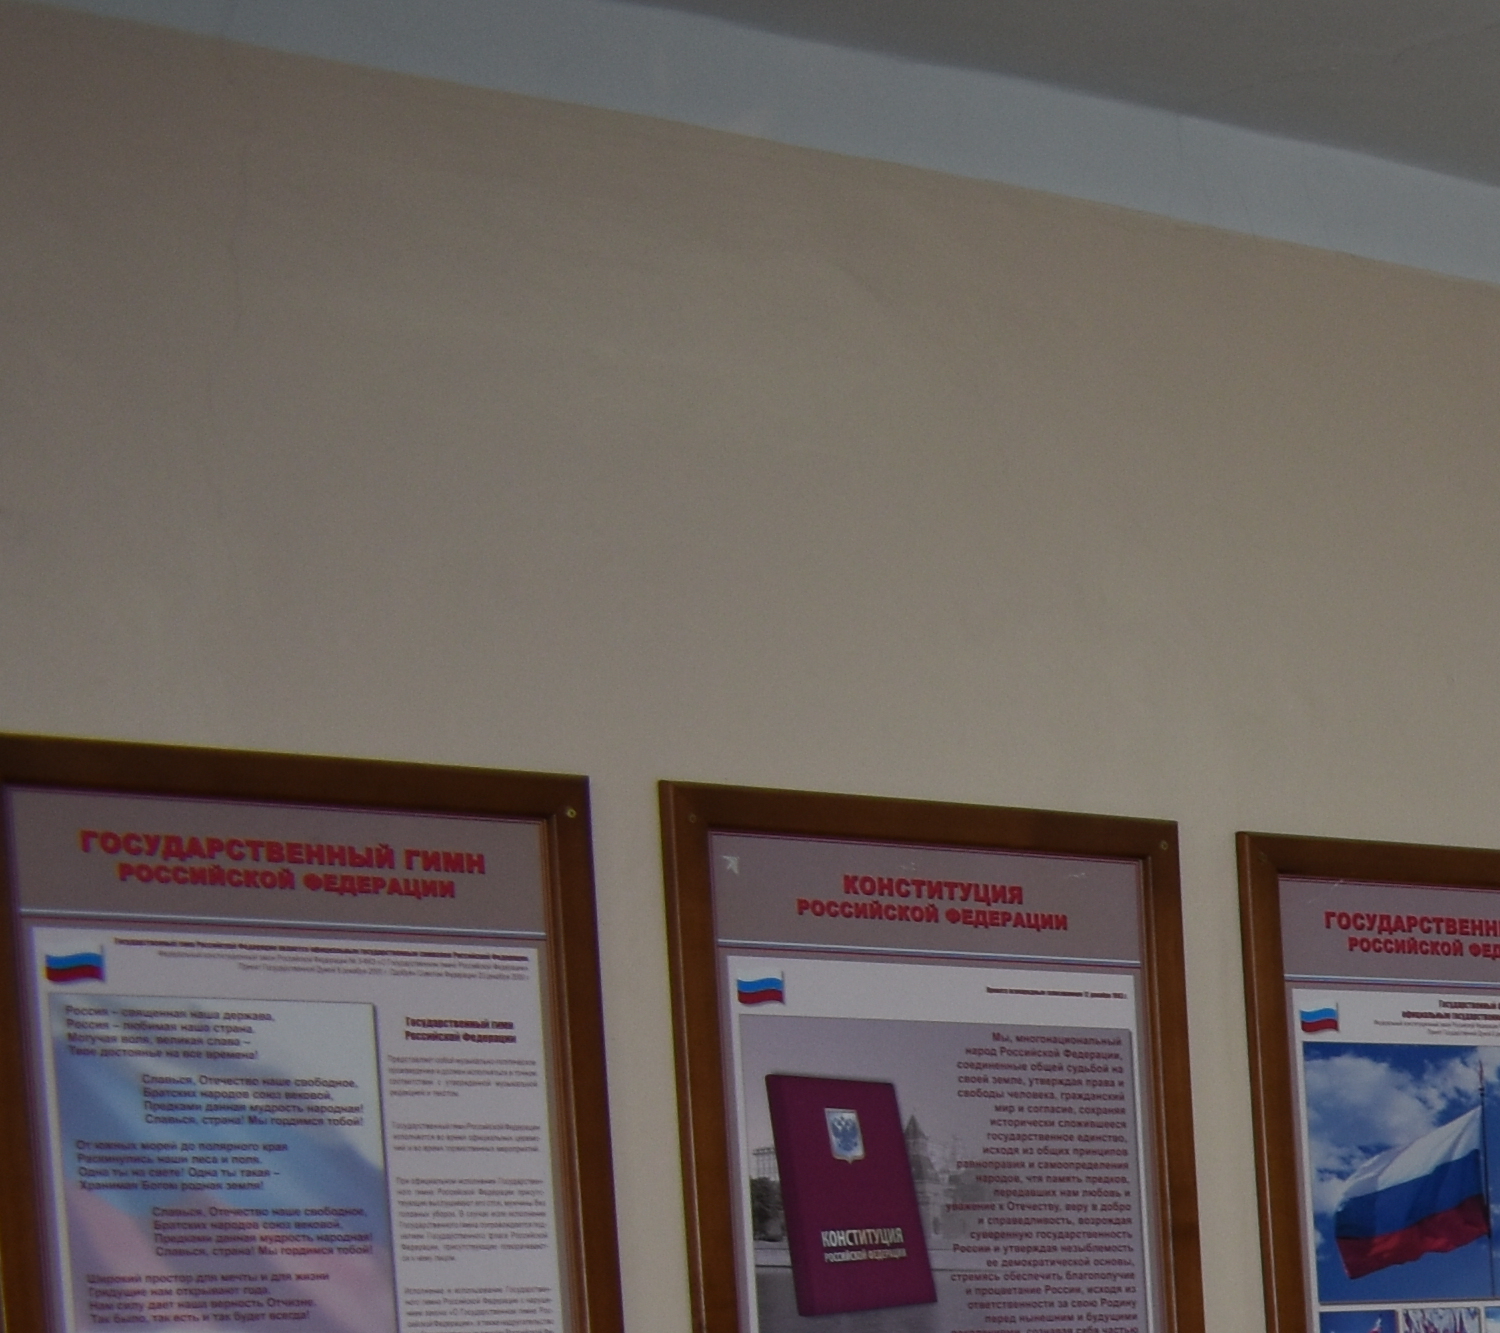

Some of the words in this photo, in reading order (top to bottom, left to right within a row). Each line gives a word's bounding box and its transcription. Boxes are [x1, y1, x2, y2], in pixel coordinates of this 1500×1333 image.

[80, 830, 394, 870] ГОСУДАРСТВЕННЫЙ
[404, 849, 486, 875] ГИМН
[119, 862, 296, 890] РОССИЙСКОЙ
[304, 873, 456, 900] ФЕДЕРАЦИИ
[843, 874, 1023, 906] КОНСТИТУЦИЯ
[797, 898, 939, 923] РОССИЙСКОЙ
[946, 908, 1068, 932] ФЕДЕРАЦИИ
[1349, 936, 1463, 956] РОССИЙСКОЙ
[1014, 1033, 1121, 1047] многонациональный
[965, 1048, 997, 1057] народ
[999, 1047, 1060, 1058] Российской
[957, 1062, 1027, 1072] соединенные
[1030, 1062, 1063, 1074] общей
[1066, 1063, 1109, 1075] судьбой
[958, 1075, 989, 1084] своей
[1028, 1078, 1083, 1088] утверждая
[1085, 1080, 1115, 1088] права
[957, 1089, 1004, 1100] свободы
[1059, 1091, 1125, 1102] гражданский
[995, 1106, 1015, 1114] мир
[1078, 1107, 1126, 1116] сохраняя
[990, 1120, 1055, 1129] исторически
[987, 1134, 1074, 1143] государственное
[983, 1148, 1019, 1157] исходя
[1036, 1146, 1069, 1157] общих
[1072, 1149, 1128, 1158] принципов
[957, 1162, 1025, 1171] равноправия
[1037, 1162, 1129, 1171] самоопределения
[821, 1228, 904, 1247] КОНСТИТУЦИЯ
[824, 1249, 866, 1262] РОССИЙСКОЙ
[868, 1248, 907, 1261] ФЕДЕРАЦИИ
